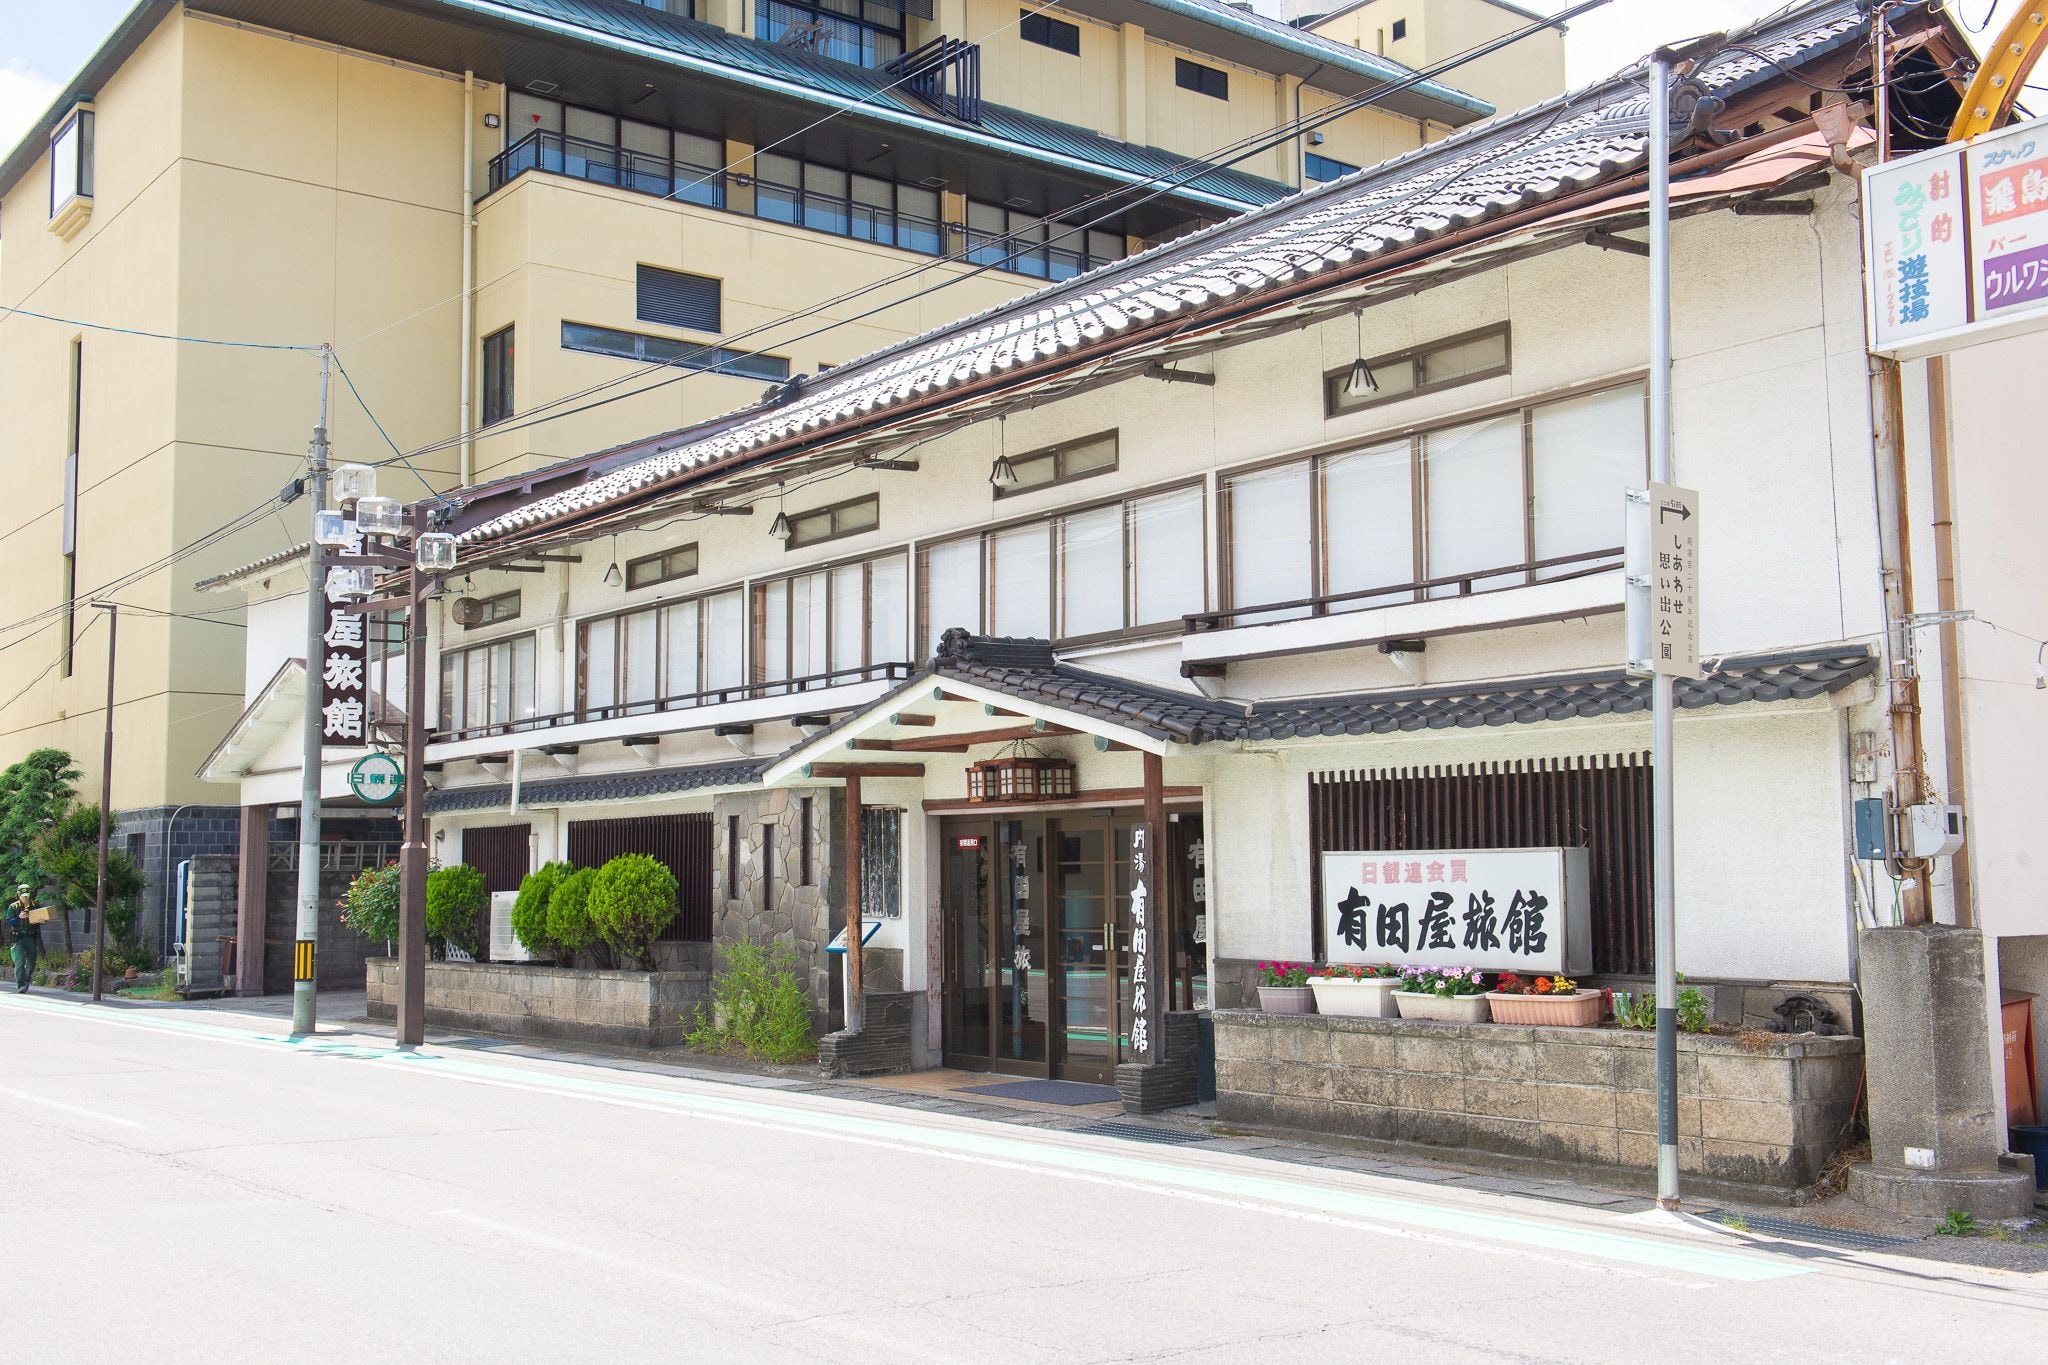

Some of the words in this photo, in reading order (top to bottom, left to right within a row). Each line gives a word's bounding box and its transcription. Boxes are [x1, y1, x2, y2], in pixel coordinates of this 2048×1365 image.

[1983, 141, 2036, 168] スナック
[1928, 169, 1953, 243] 射的
[1984, 169, 2048, 217] 飛鳥
[1988, 232, 2028, 253] バー
[1659, 551, 1672, 660] 思い出公園
[1673, 534, 1684, 614] しあわせ
[1361, 859, 1468, 885] 日観連会員
[1010, 839, 1032, 1006] 有田屋旅
[1336, 885, 1550, 956] 有田屋旅館
